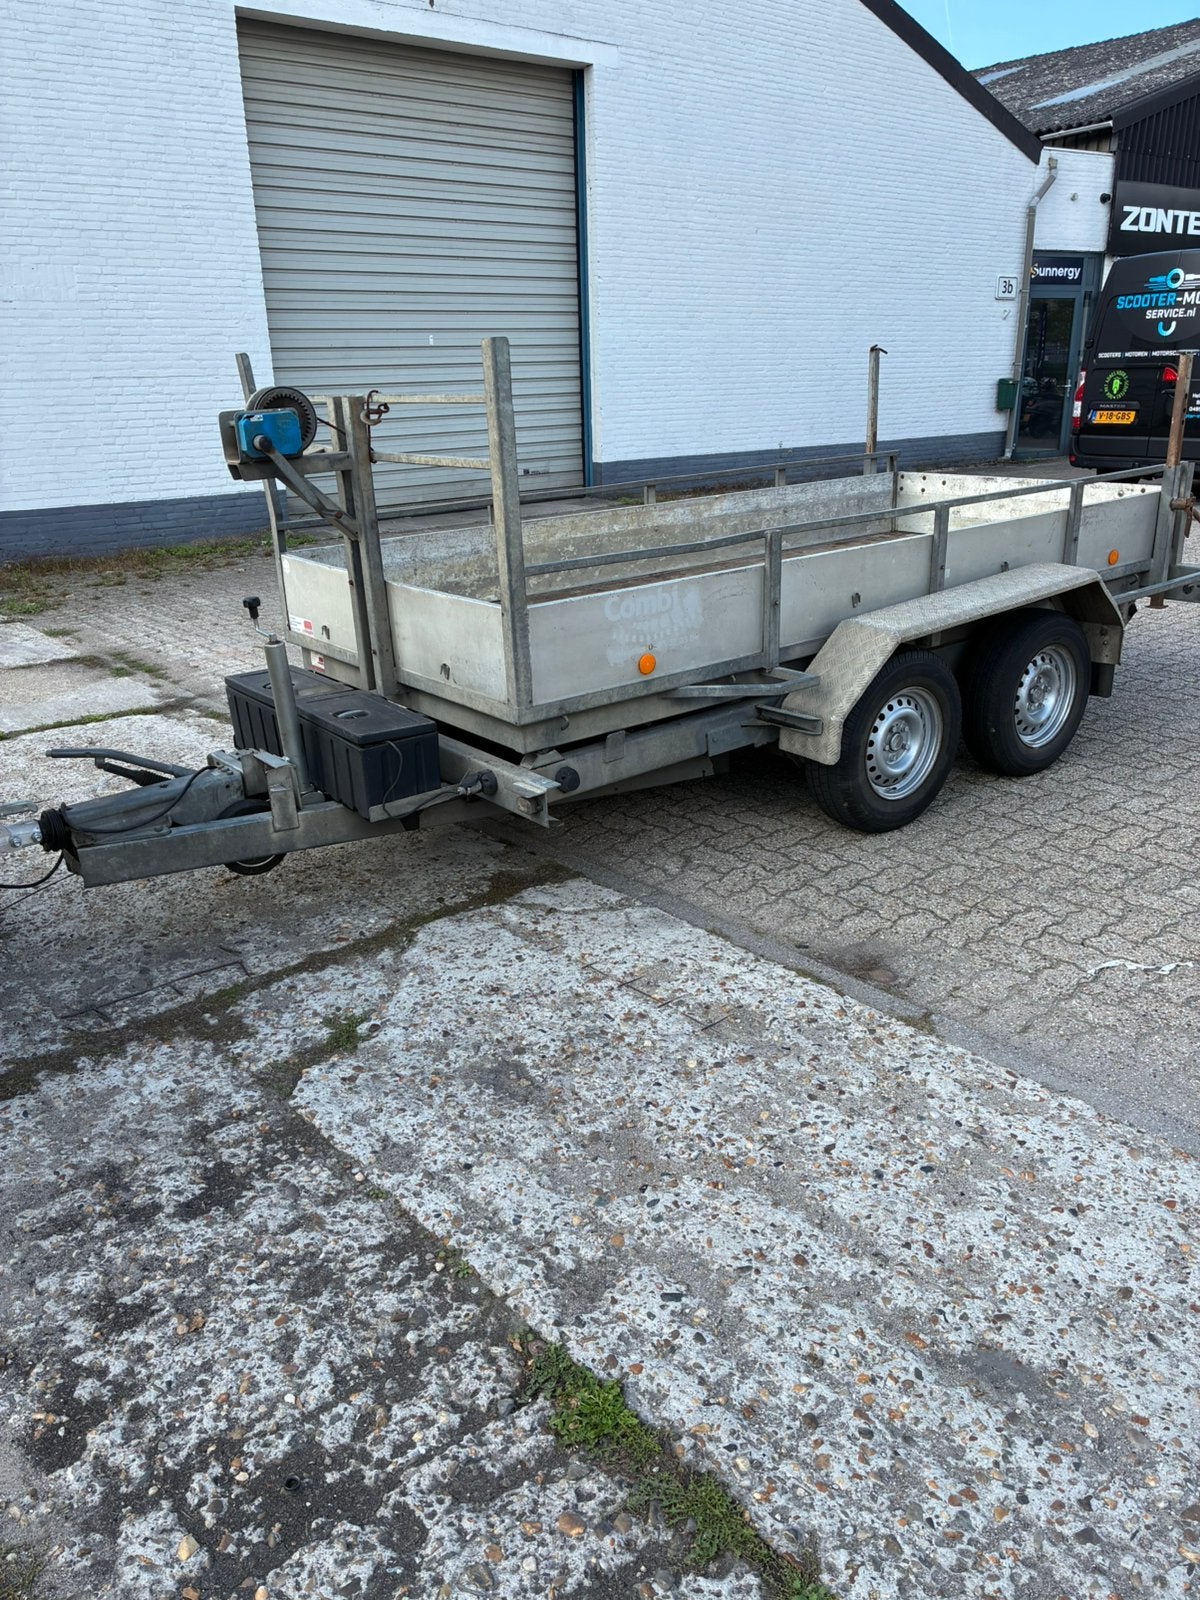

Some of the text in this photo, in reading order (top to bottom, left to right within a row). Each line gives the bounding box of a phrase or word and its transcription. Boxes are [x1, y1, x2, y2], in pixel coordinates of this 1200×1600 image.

[1120, 206, 1200, 235] ZONTE
[1031, 263, 1081, 280] Sunnergy
[1002, 280, 1013, 294] 3b
[1145, 307, 1196, 319] SERVICE.nl
[1099, 412, 1131, 420] V-18-GBS
